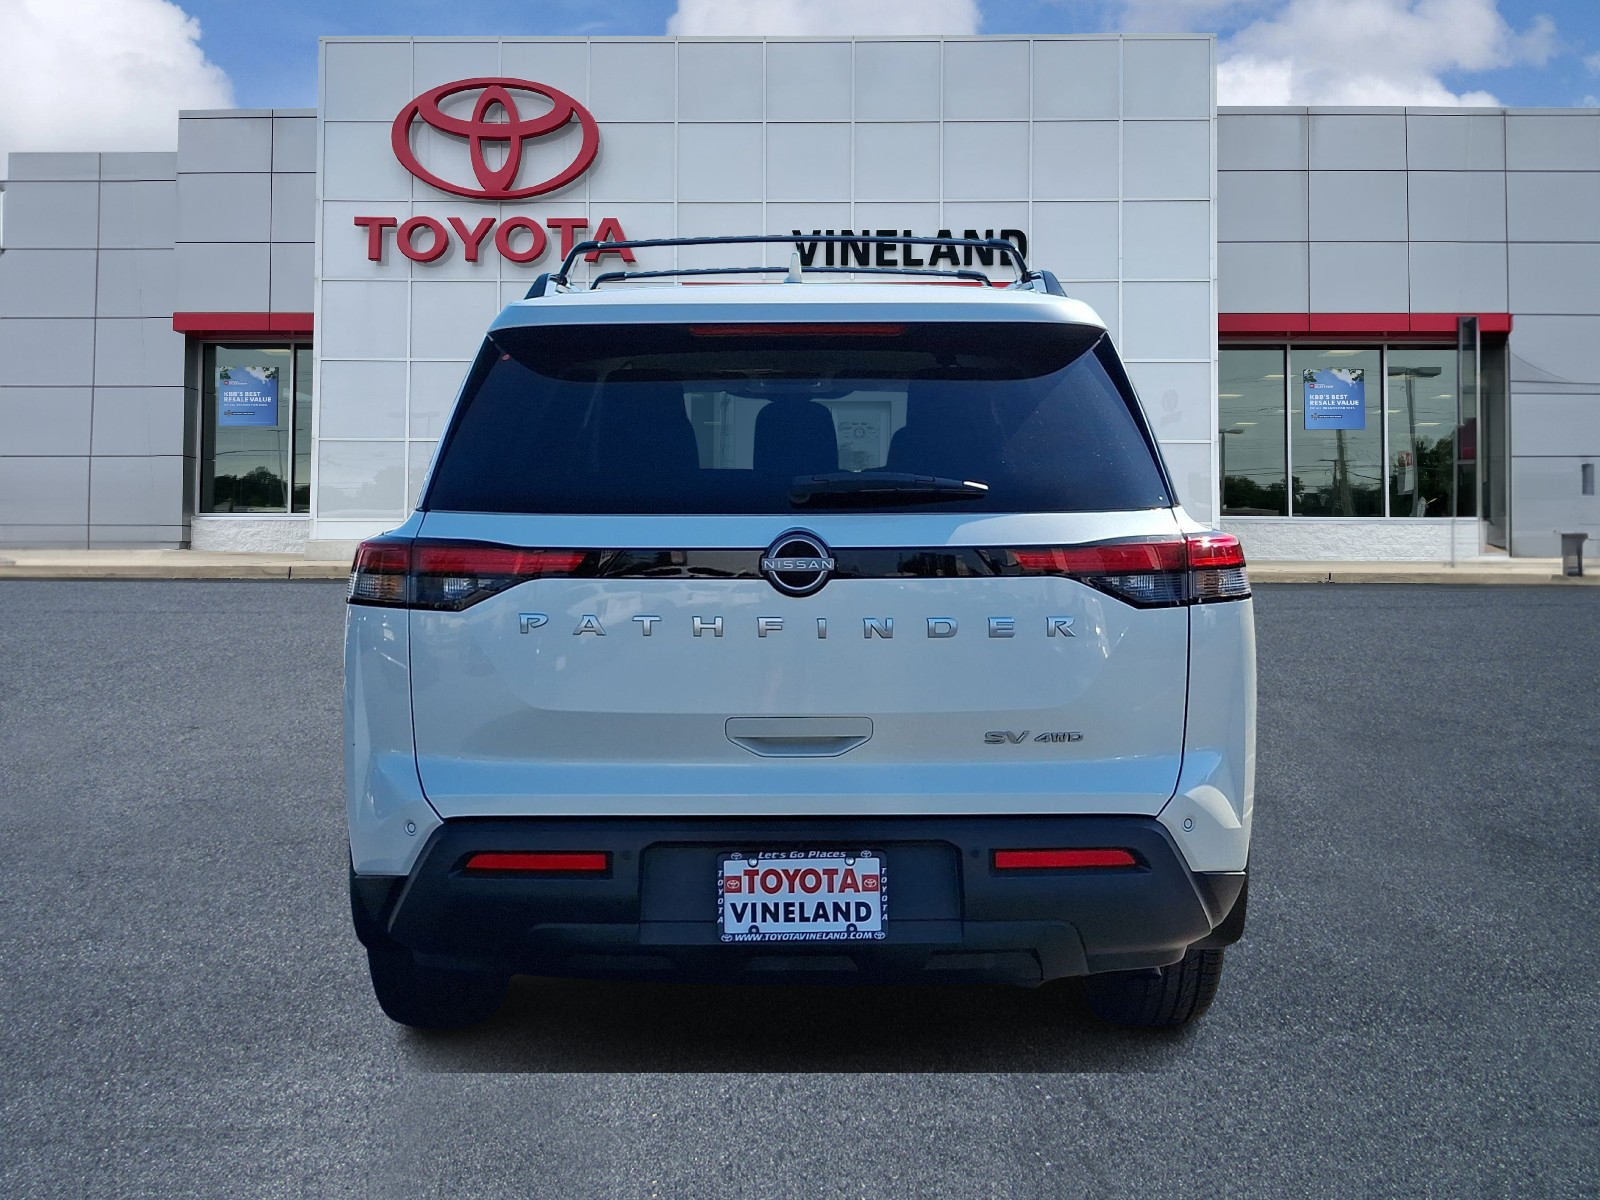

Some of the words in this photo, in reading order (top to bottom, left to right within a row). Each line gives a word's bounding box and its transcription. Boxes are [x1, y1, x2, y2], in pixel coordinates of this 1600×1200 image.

[354, 215, 637, 263] TOYOTA
[792, 229, 1028, 266] VINELAND
[764, 560, 832, 569] NISSAN
[518, 613, 1077, 639] PATHFINDER
[984, 730, 1030, 745] SV
[1034, 731, 1084, 743] 4WD
[758, 851, 787, 859] Let's
[789, 851, 804, 859] Go
[808, 851, 847, 859] Places
[743, 867, 861, 895] TOYOTA
[730, 901, 872, 924] VINELAND
[734, 931, 873, 942] WWW.TOYOTAVINELAND.COM
